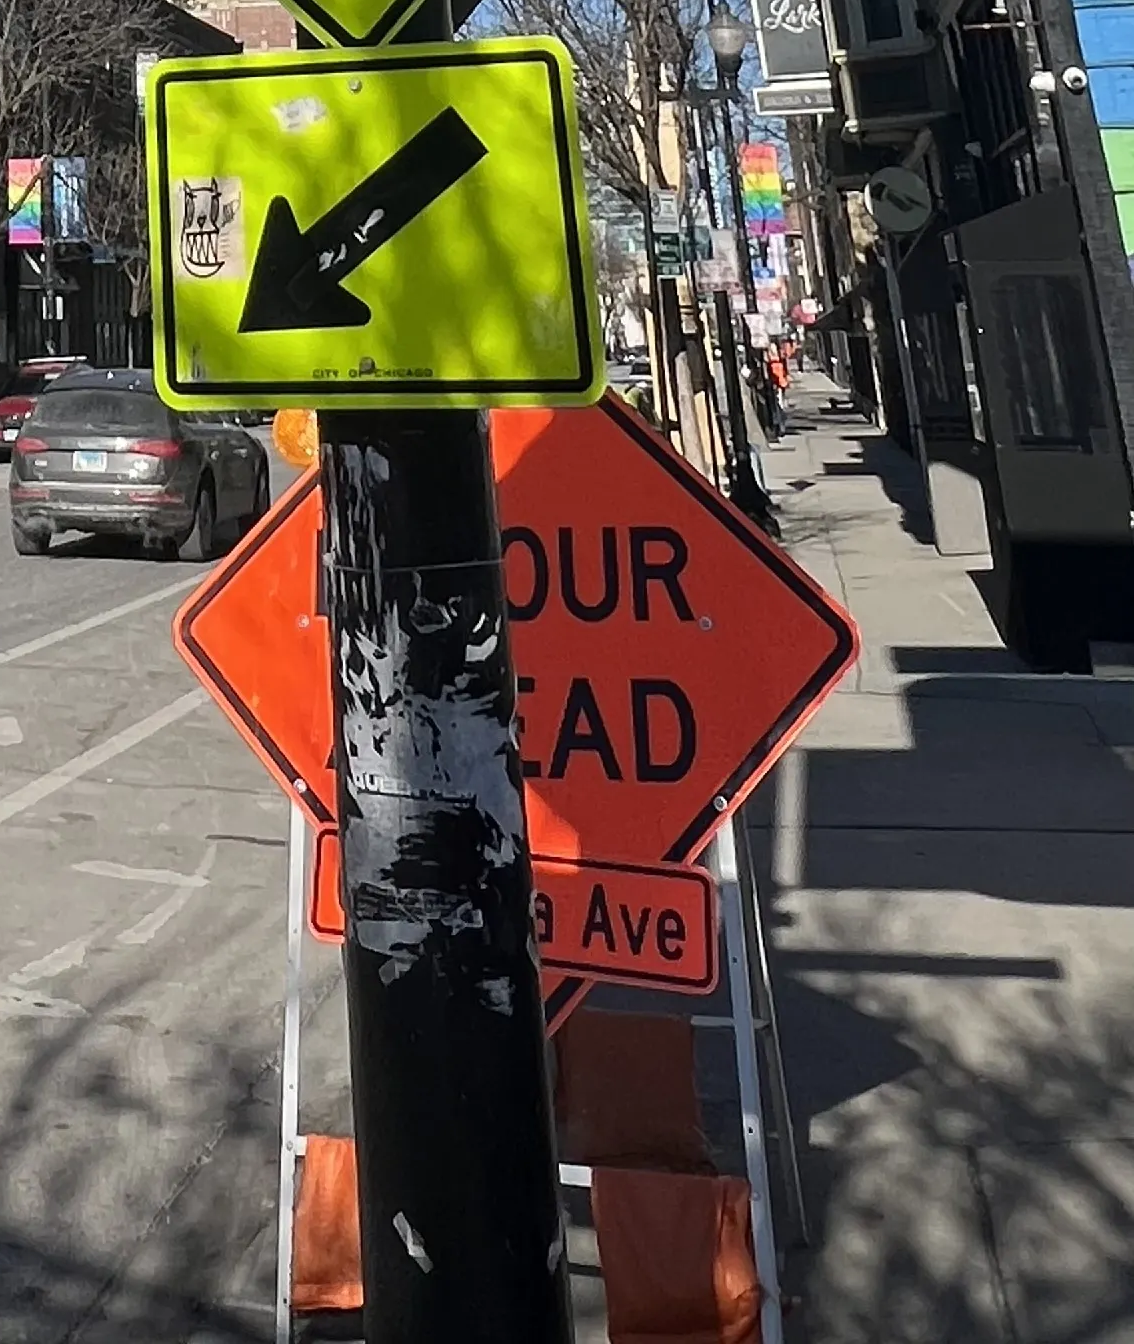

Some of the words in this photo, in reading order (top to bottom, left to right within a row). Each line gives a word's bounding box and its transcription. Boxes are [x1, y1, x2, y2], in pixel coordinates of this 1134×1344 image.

[312, 368, 339, 378] CITY
[374, 368, 434, 378] CHICAGO
[582, 883, 686, 961] Ave
